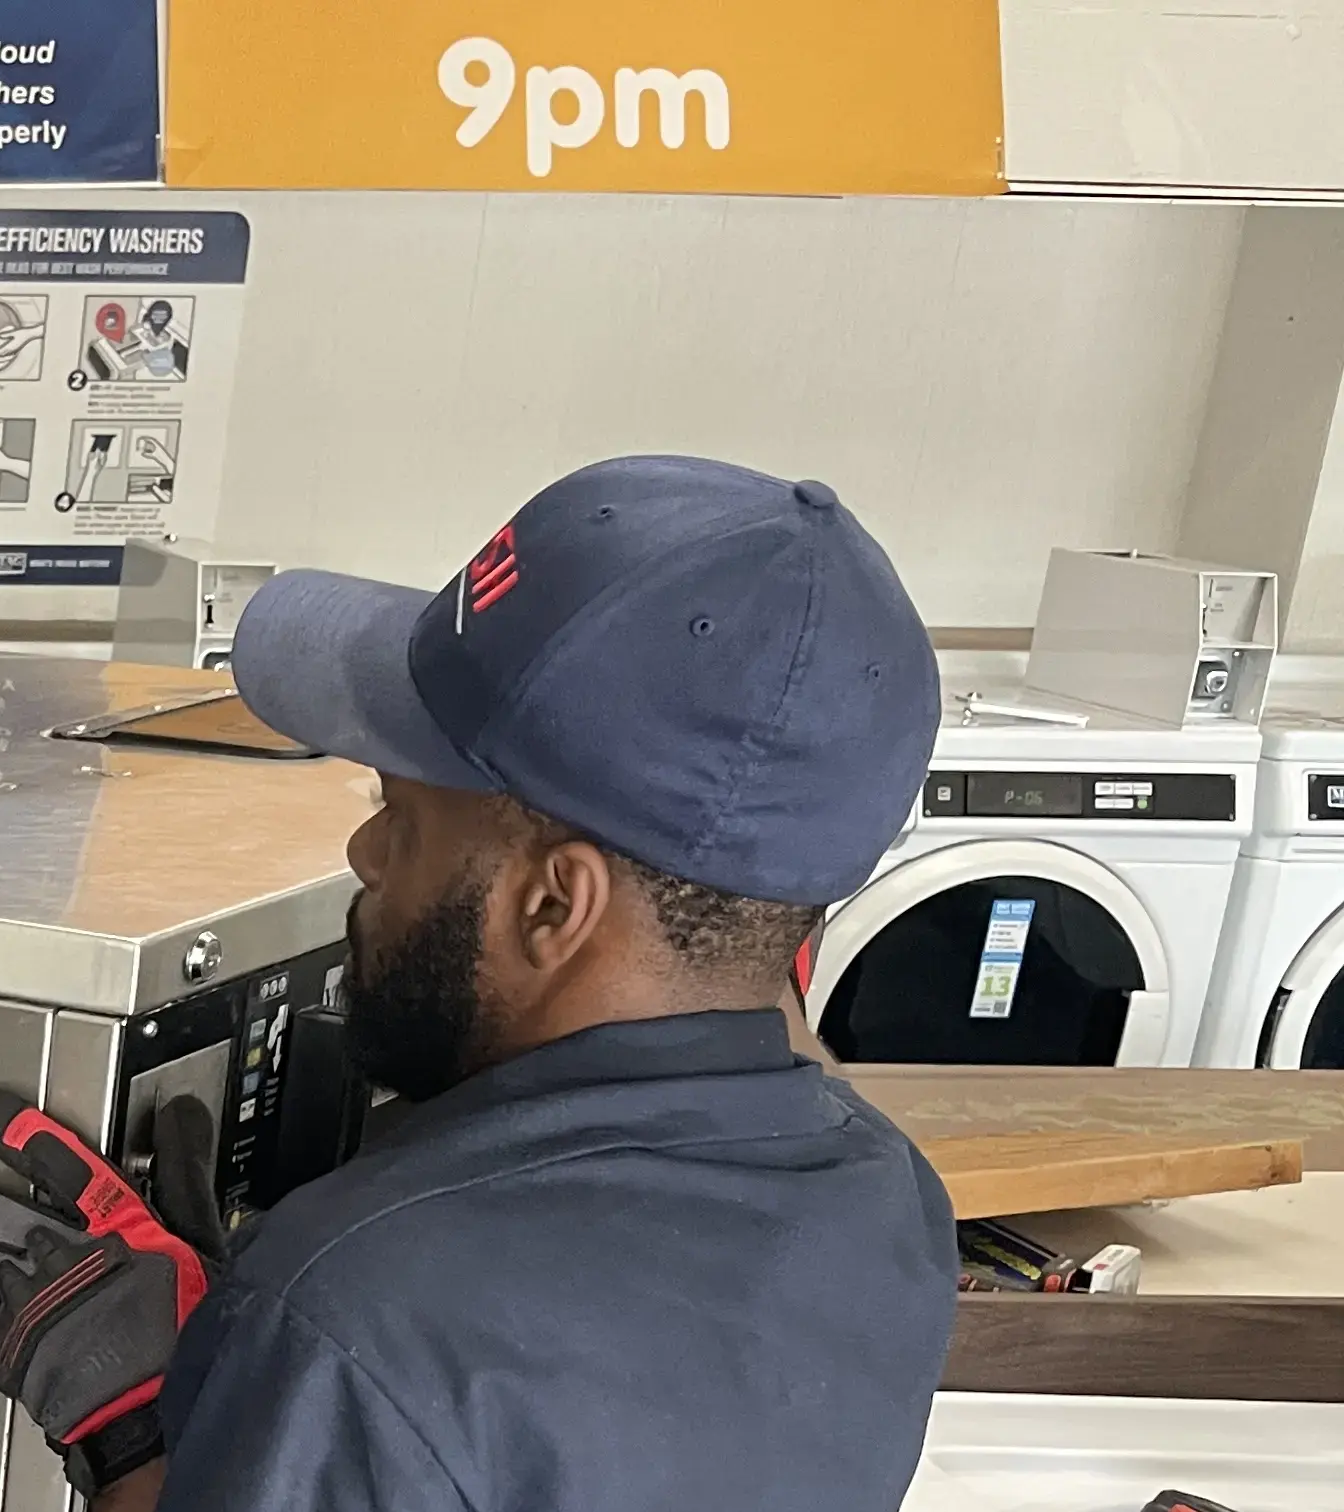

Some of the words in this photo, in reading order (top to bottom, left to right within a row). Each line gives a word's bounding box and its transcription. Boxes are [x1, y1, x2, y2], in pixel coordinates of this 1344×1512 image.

[437, 36, 730, 177] 9pm
[109, 227, 204, 254] WASHERS
[981, 976, 1011, 996] 13
